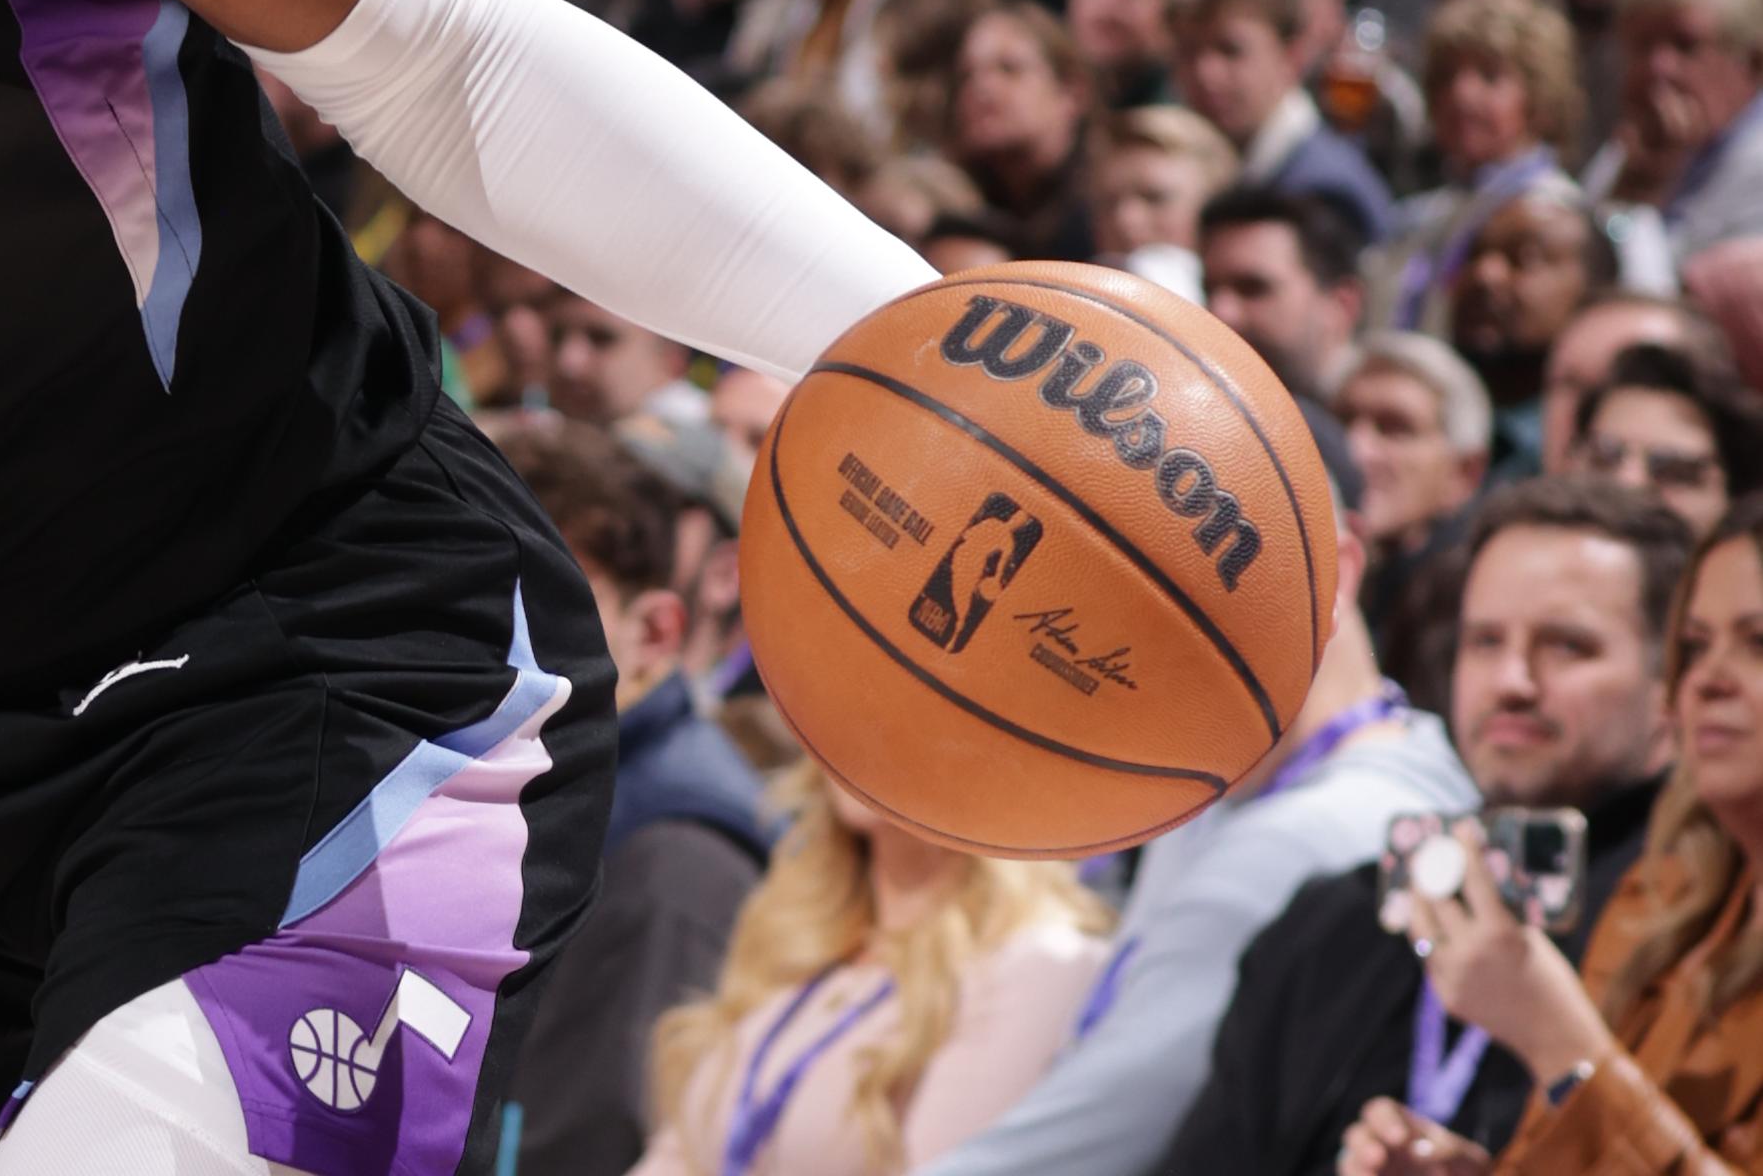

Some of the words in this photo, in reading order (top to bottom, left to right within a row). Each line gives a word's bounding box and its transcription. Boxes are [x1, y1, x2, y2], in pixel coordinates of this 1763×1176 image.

[939, 295, 1263, 593] Wilson
[838, 452, 882, 501] OFFICIAL
[874, 486, 911, 523] GAME
[902, 509, 935, 546] BALL
[915, 597, 951, 636] NBA
